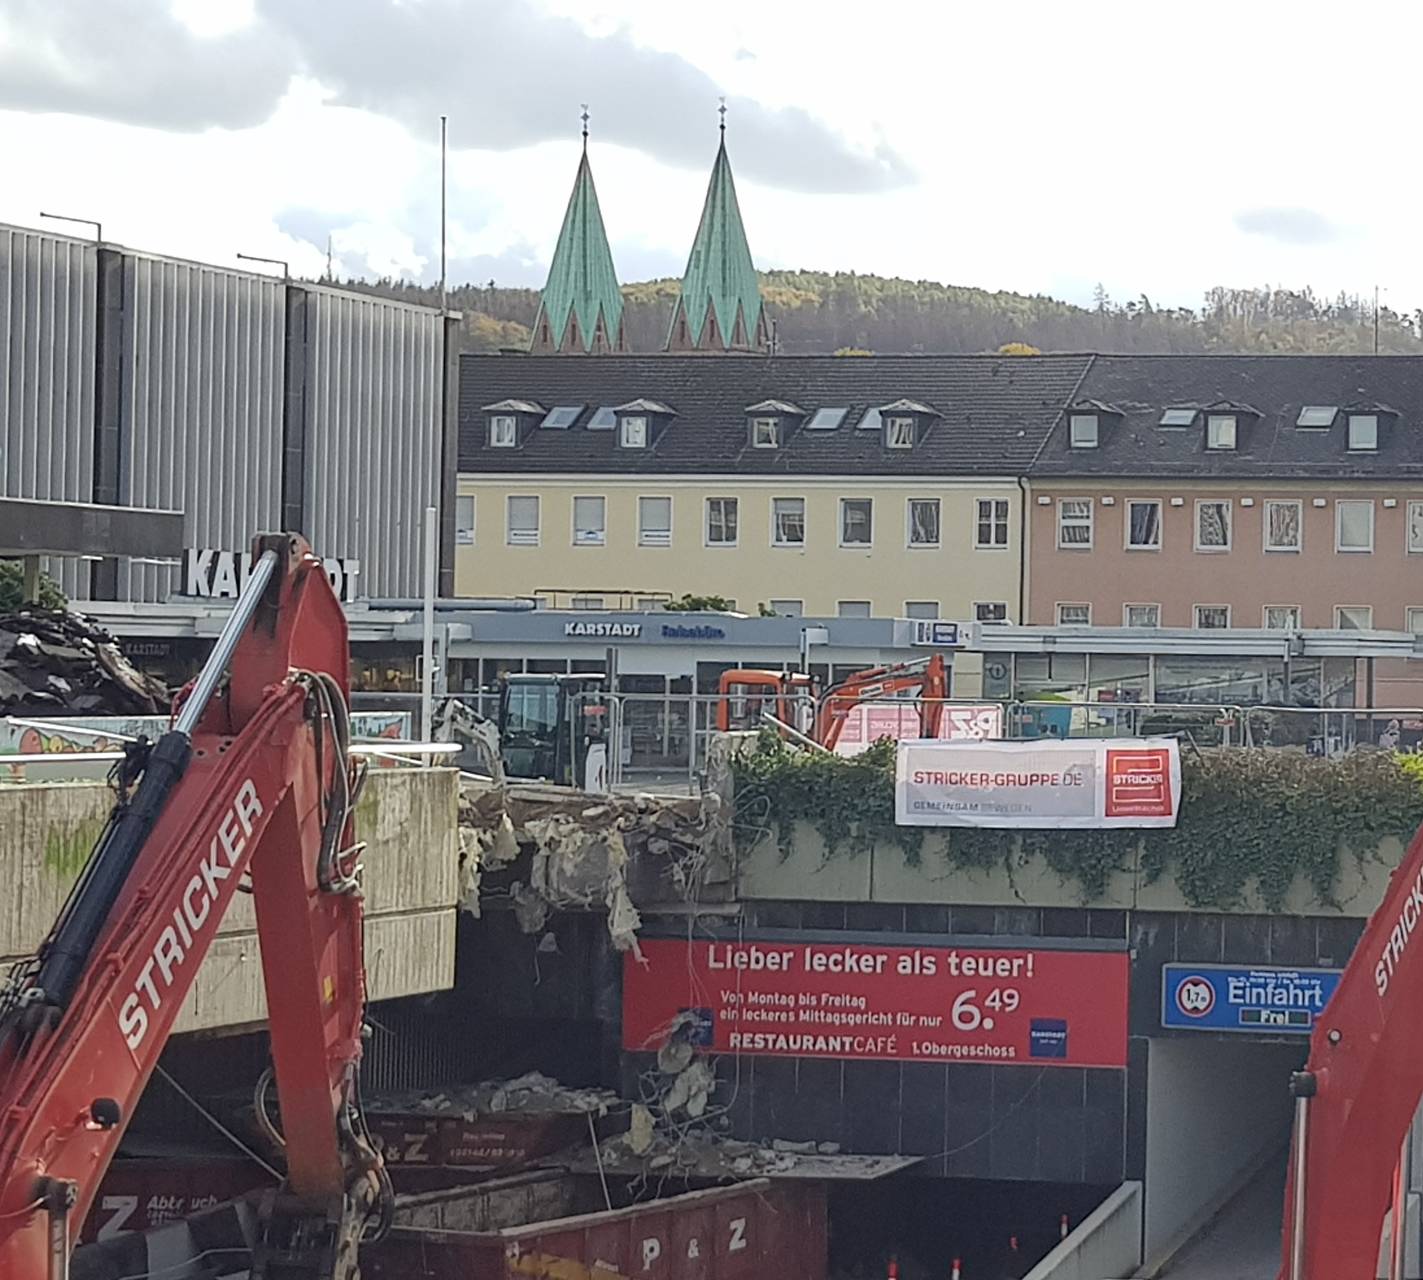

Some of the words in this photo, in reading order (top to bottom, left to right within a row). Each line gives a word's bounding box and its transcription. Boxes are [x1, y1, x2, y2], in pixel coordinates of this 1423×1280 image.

[187, 549, 360, 602] KADT
[565, 624, 640, 637] KARSTADT
[119, 779, 263, 1050] STRICKER
[708, 945, 794, 971] Lieber
[805, 947, 888, 974] lecker
[897, 951, 936, 975] als
[948, 951, 1034, 978] teuer!
[720, 990, 744, 1004] Von
[748, 992, 795, 1008] Montag
[799, 993, 817, 1006] bis
[821, 994, 866, 1010] Freitag
[1228, 981, 1323, 1007] Einfahrt
[720, 1007, 739, 1020] ein
[743, 1009, 795, 1022] leckeres
[799, 1010, 893, 1026] Mittagsgericht
[897, 1013, 916, 1027] für
[919, 1017, 943, 1027] nur
[404, 1134, 429, 1161] Z
[643, 1238, 661, 1270] P
[729, 1218, 747, 1250] Z
